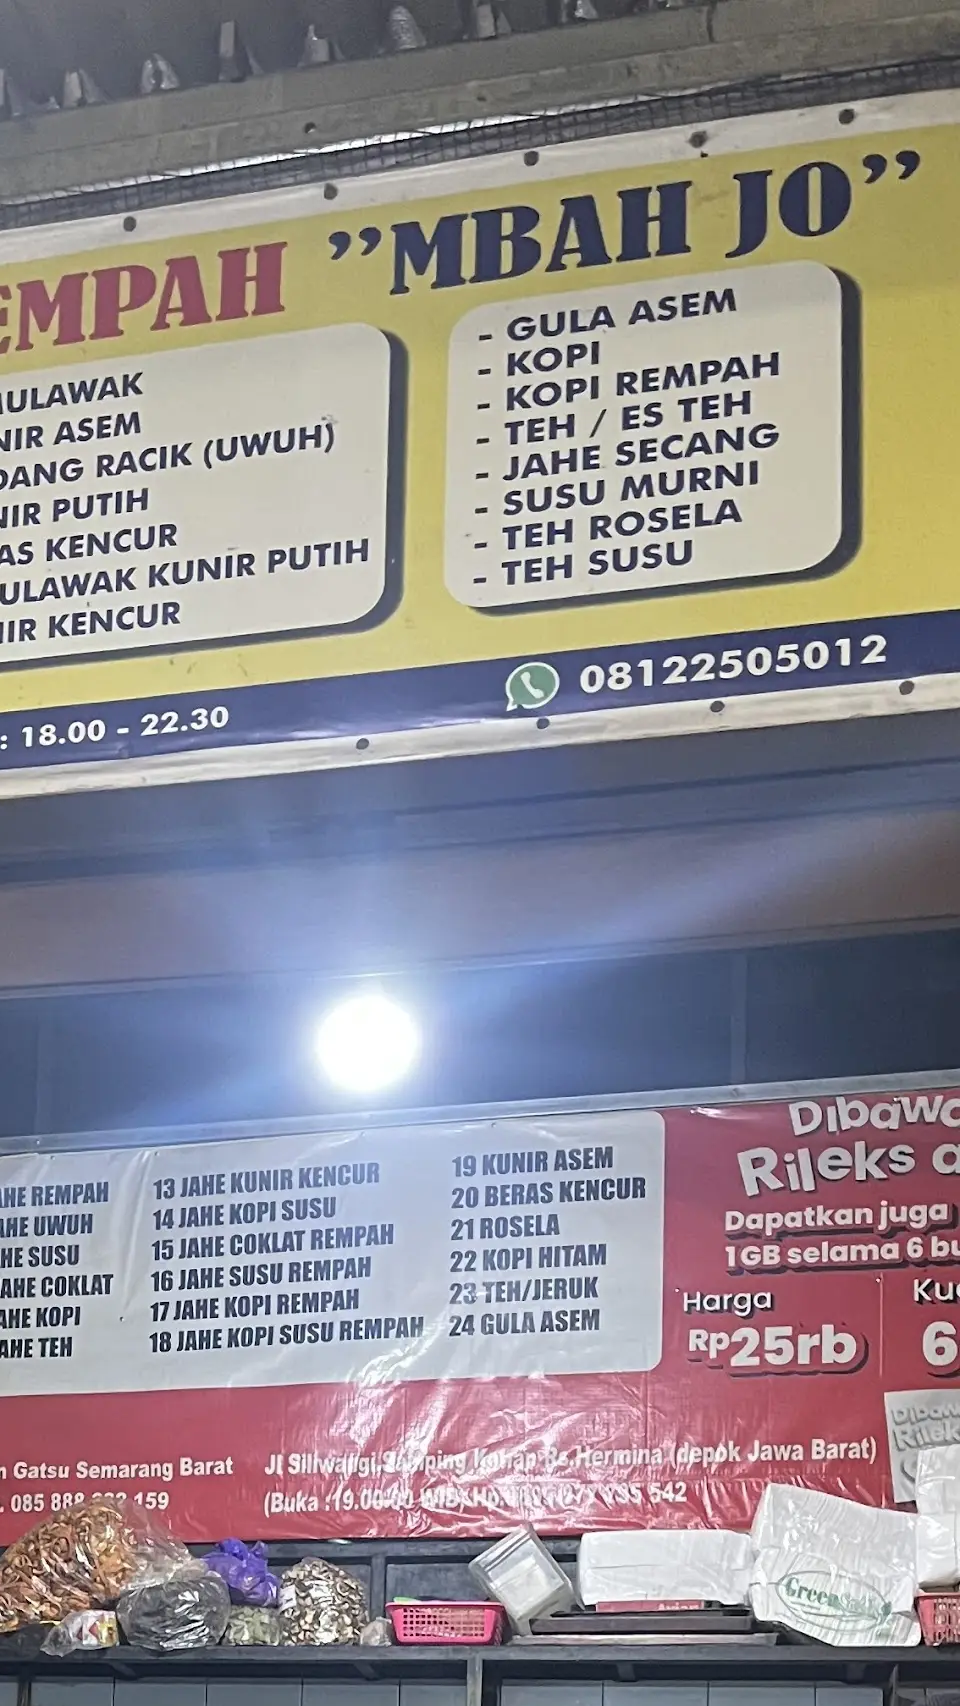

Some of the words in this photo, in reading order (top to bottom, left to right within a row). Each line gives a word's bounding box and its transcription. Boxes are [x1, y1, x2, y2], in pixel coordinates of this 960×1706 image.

[507, 306, 615, 340] GULA
[629, 289, 736, 325] ASEM
[508, 341, 599, 376] KOPI
[97, 443, 192, 477] RACIK
[204, 423, 333, 469] (UWUH)
[503, 445, 600, 480] JAHE
[615, 424, 779, 467] SECANG
[53, 488, 148, 522] PUTIH
[503, 519, 572, 550] TEH
[590, 499, 742, 540] ROSELA
[47, 524, 177, 561] KENCUR
[579, 634, 887, 694] 08122505012
[22, 720, 105, 747] 18.00
[141, 707, 228, 736] 22.30
[452, 1156, 476, 1177] 19
[483, 1151, 548, 1175] KUNIR
[554, 1146, 613, 1171] ASEM
[737, 1141, 915, 1196] Rileks
[31, 1182, 108, 1206] REMPAH
[153, 1179, 175, 1199] 13
[180, 1174, 225, 1197] JAHE
[231, 1169, 292, 1194] KUNIR
[299, 1163, 379, 1188] KENCUR
[451, 1187, 478, 1208] 20
[485, 1182, 553, 1207] BERAS
[560, 1177, 645, 1202] KENCUR
[34, 1214, 93, 1236] UWUH
[451, 1219, 474, 1240] 21
[480, 1214, 560, 1239] ROSELA
[725, 1205, 872, 1236] Dapatkan
[878, 1200, 947, 1230] juga
[28, 1245, 79, 1267] SUSU
[152, 1240, 173, 1260] 15
[179, 1236, 224, 1259] JAHE
[230, 1230, 305, 1255] COKLAT
[311, 1224, 393, 1250] REMPAH
[725, 1245, 780, 1267] 1GB
[787, 1241, 899, 1264] selama
[907, 1237, 923, 1258] 6
[450, 1250, 476, 1272] 22
[483, 1248, 532, 1271] KOPI
[539, 1244, 606, 1268] HITAM
[42, 1274, 113, 1297] COKLAT
[450, 1283, 476, 1304] 23
[483, 1277, 598, 1303] TEH/JERUK
[36, 1307, 80, 1327] KOPI
[684, 1292, 770, 1316] Harga
[149, 1332, 171, 1352] 18
[177, 1329, 222, 1351] JAHE
[228, 1326, 273, 1348] KOPI
[280, 1322, 333, 1344] SUSU
[340, 1317, 423, 1341] REMPAH
[449, 1315, 475, 1336] 24
[481, 1312, 535, 1335] GULA
[540, 1309, 599, 1332] ASEM
[38, 1337, 72, 1357] TEH
[689, 1325, 856, 1366] Rp25rb
[670, 1440, 741, 1467] (depok
[747, 1440, 803, 1464] Jawa
[812, 1437, 876, 1464] Barat)
[14, 1462, 69, 1479] Gatsu
[76, 1461, 173, 1481] Semarang
[180, 1457, 233, 1476] Barat
[11, 1494, 44, 1512] 085
[647, 1481, 687, 1505] 542
